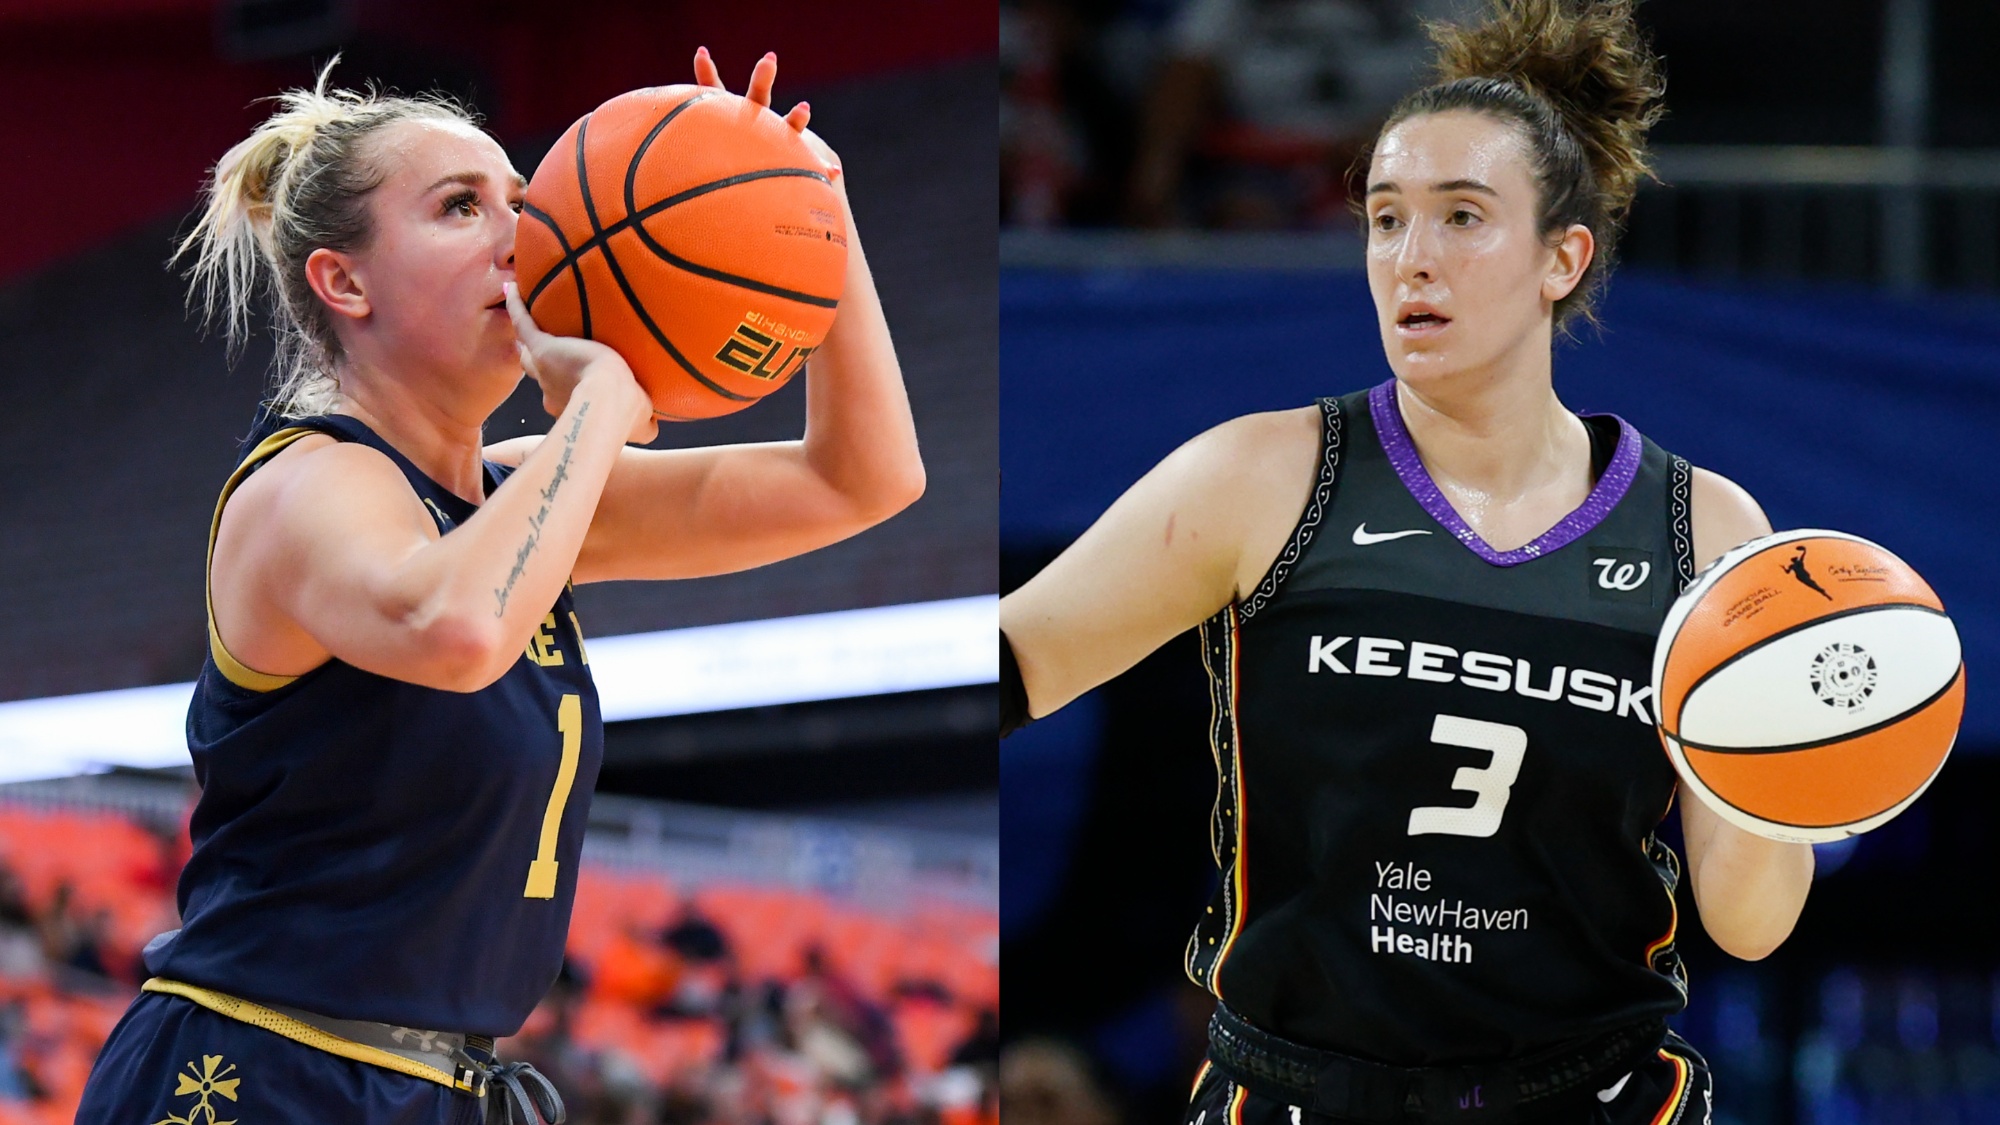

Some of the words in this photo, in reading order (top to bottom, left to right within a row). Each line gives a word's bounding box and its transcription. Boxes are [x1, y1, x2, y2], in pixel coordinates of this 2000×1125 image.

[713, 322, 820, 381] ELIT
[1308, 635, 1654, 726] KEESUSK
[523, 694, 582, 899] 1
[1407, 713, 1528, 838] 3
[1374, 861, 1432, 892] Yale
[1370, 893, 1529, 931] NewHaven
[1371, 926, 1473, 964] Health
